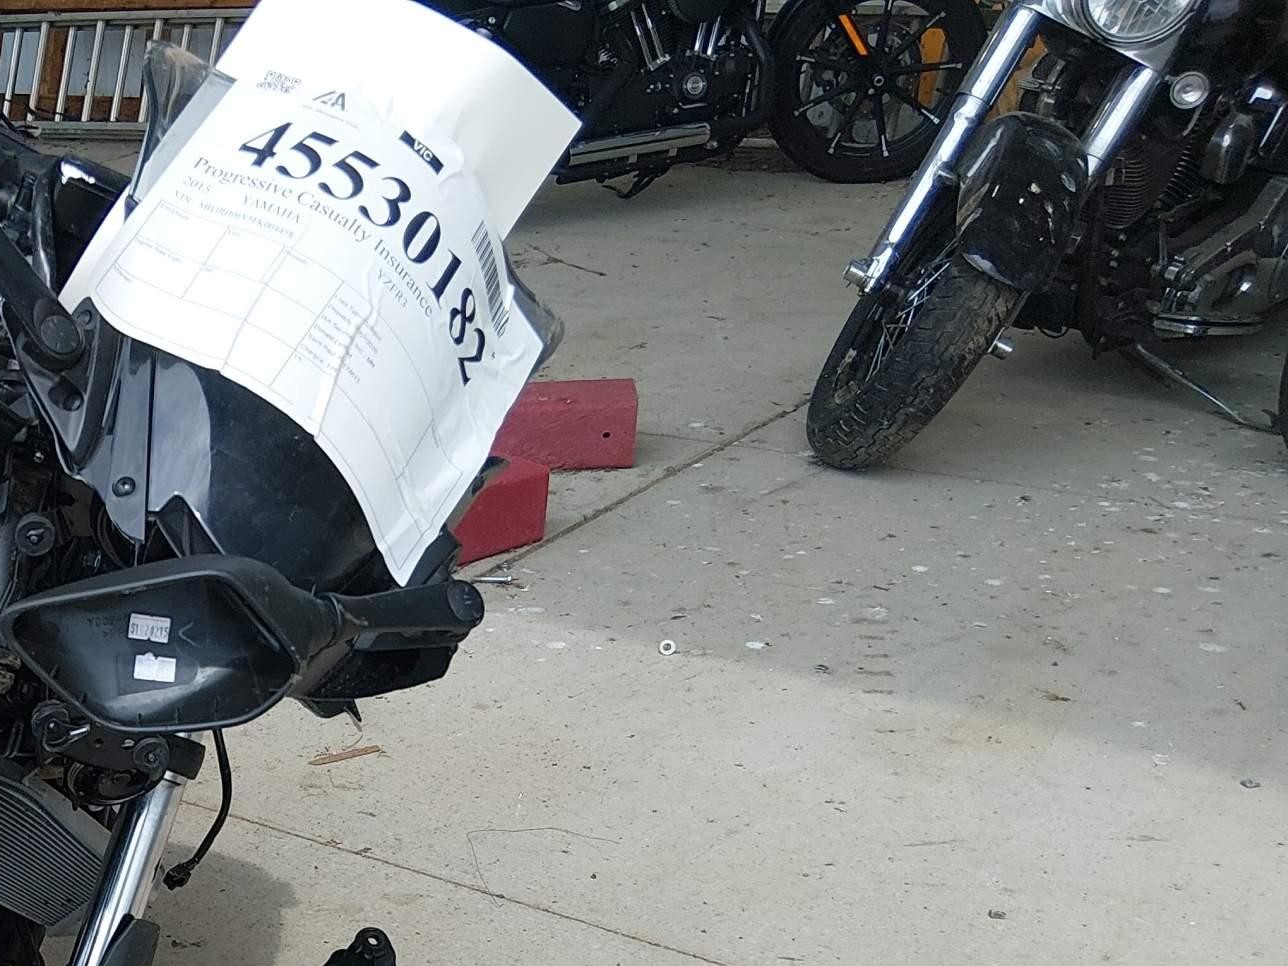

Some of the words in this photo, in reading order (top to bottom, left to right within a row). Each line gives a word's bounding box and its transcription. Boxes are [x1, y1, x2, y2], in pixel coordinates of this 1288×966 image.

[183, 176, 212, 193] 2015
[242, 194, 300, 225] YAMAHA
[413, 139, 433, 162] VIC
[193, 156, 293, 199] Progressive
[297, 191, 372, 243] Casualty
[374, 239, 433, 317] Insurance
[238, 122, 486, 387] 45530182
